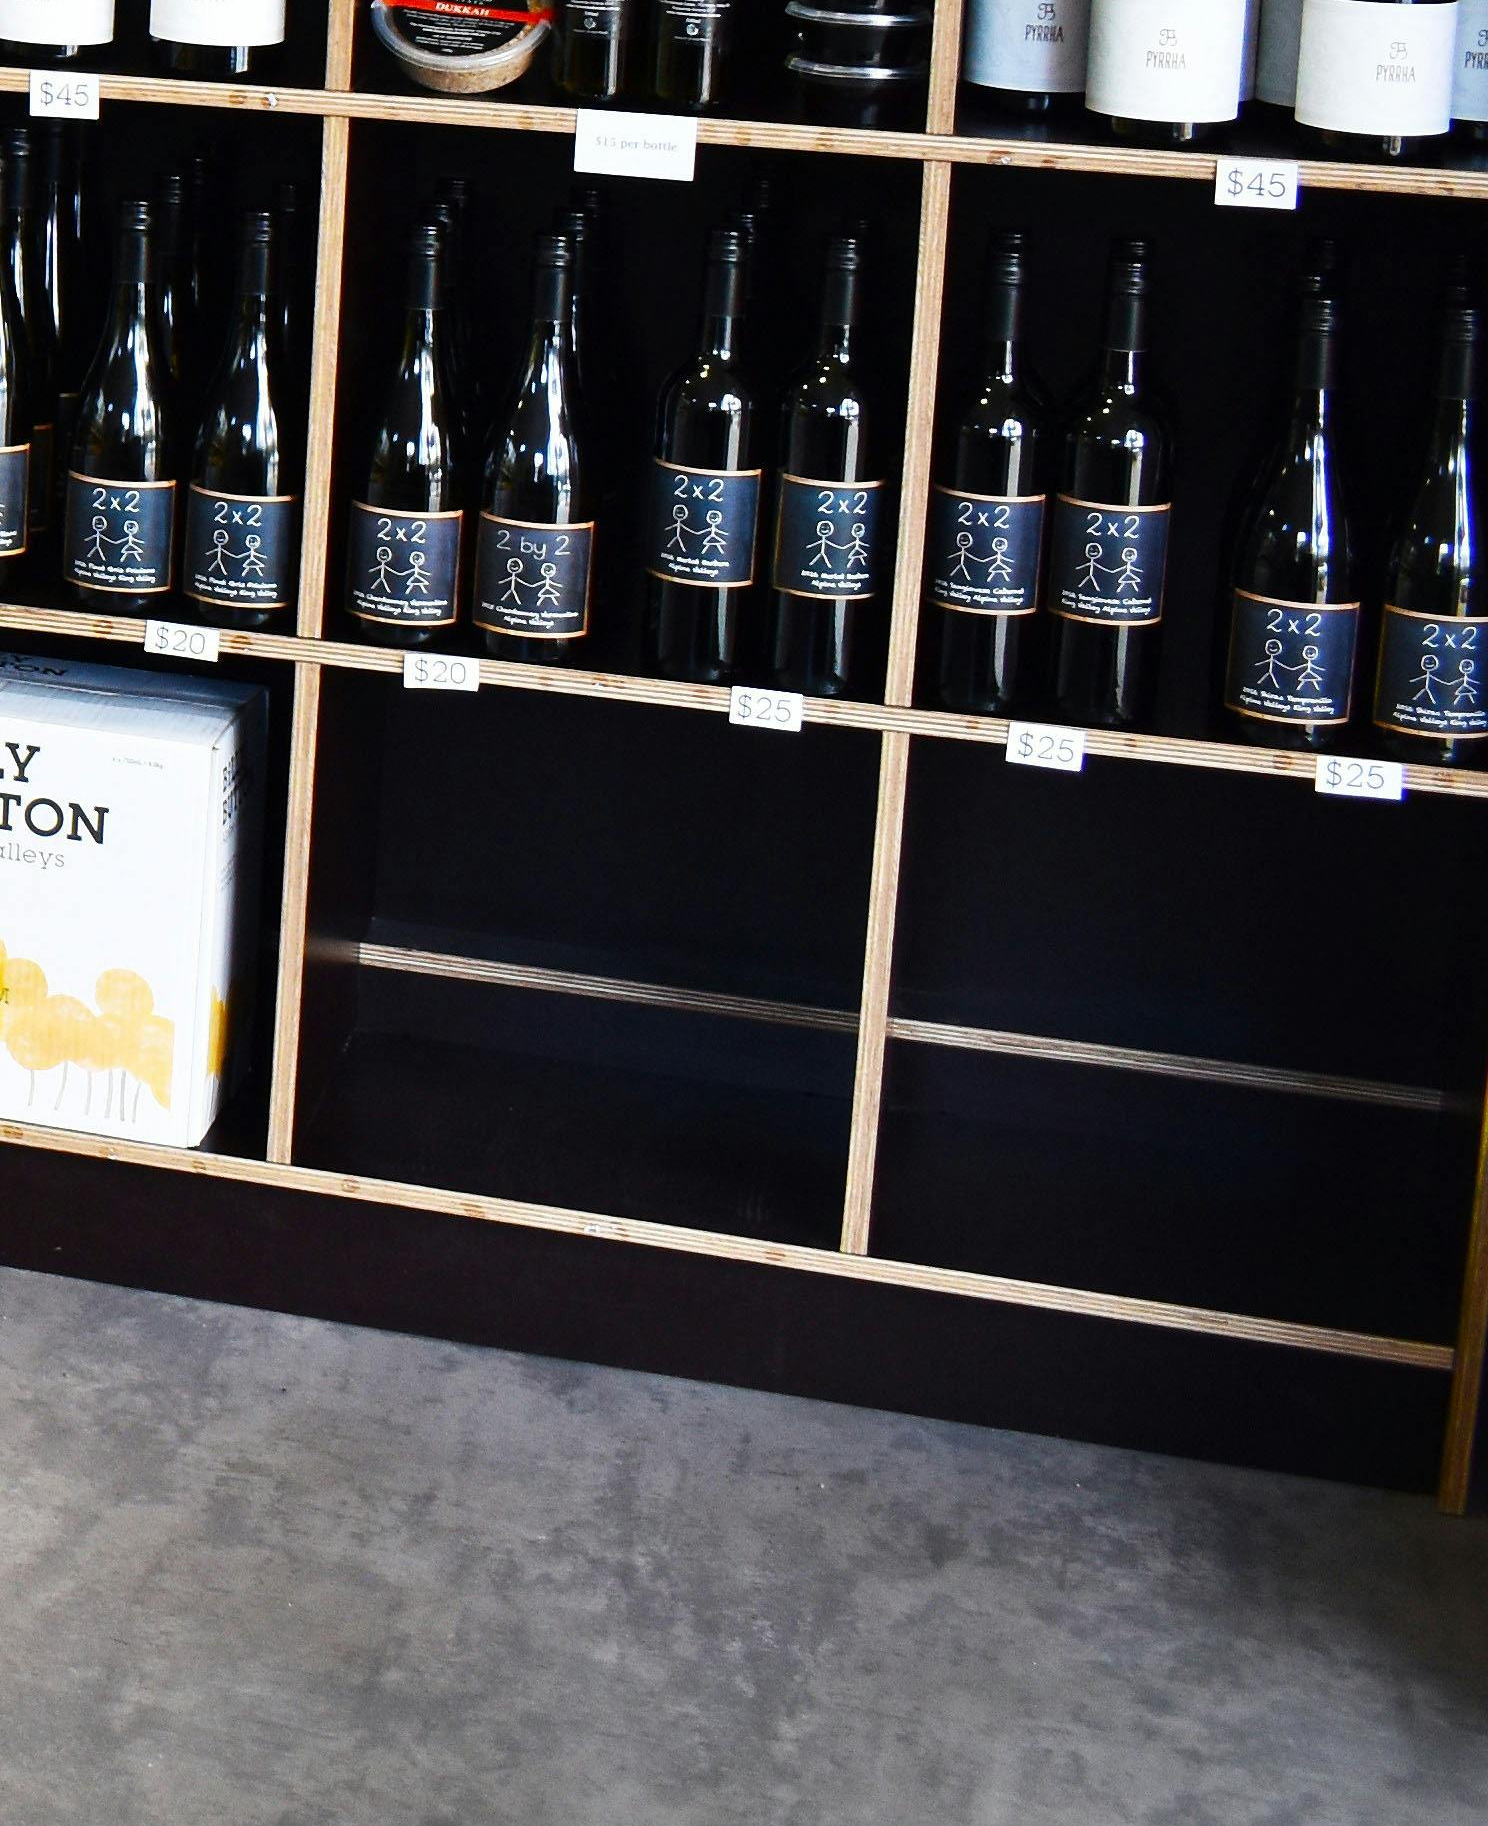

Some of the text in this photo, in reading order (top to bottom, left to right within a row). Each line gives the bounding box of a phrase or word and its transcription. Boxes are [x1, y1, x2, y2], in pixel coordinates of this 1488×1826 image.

[435, 2, 490, 16] DUKKAH
[1024, 24, 1065, 43] PYRRHA
[1145, 50, 1187, 70] PYRRHA
[1376, 64, 1416, 82] PYRRHA
[40, 81, 89, 107] $45
[620, 140, 639, 150] per
[643, 139, 678, 151] bottle
[1227, 167, 1286, 197] $45
[496, 529, 571, 561] 2 by 2
[154, 627, 207, 657] $20
[414, 658, 467, 686] $20
[736, 692, 794, 725] $25
[1016, 729, 1075, 762] $25
[1324, 759, 1386, 791] $25
